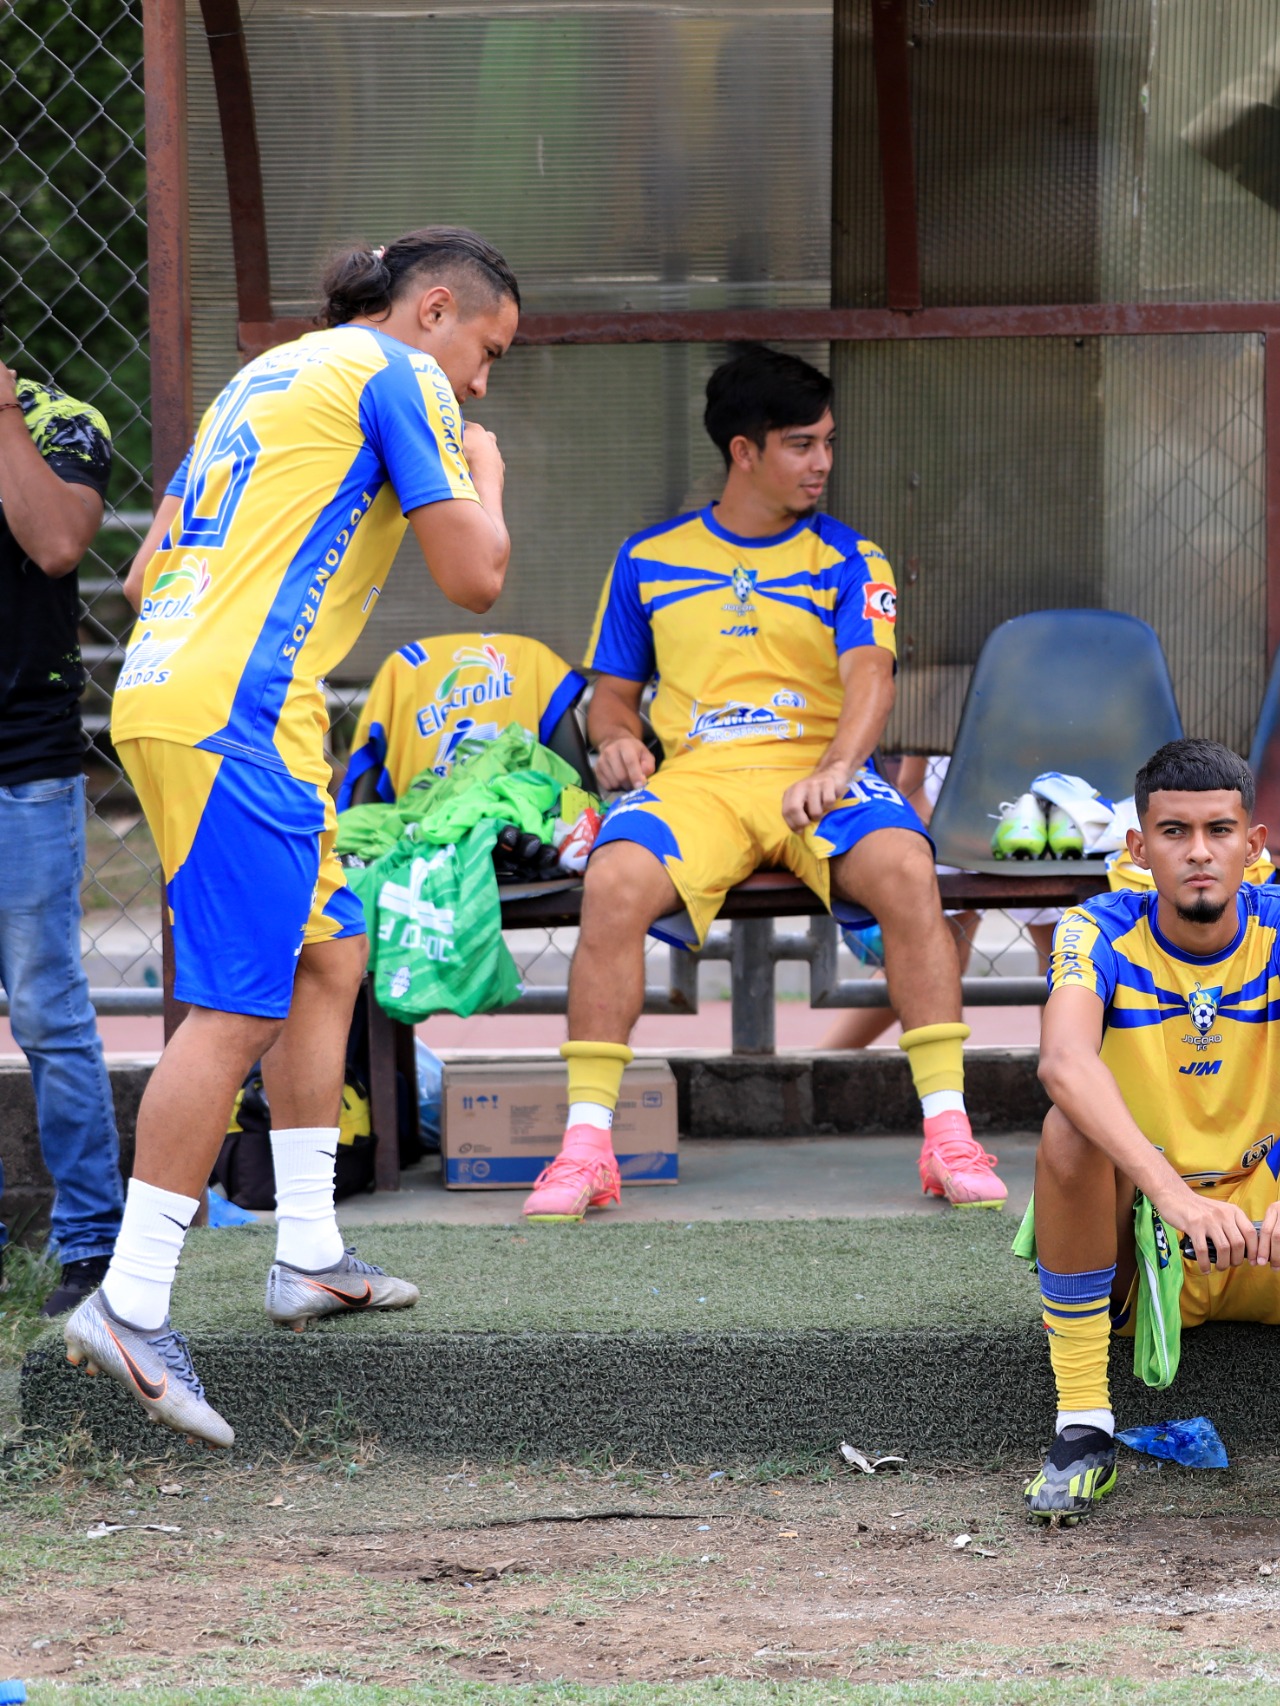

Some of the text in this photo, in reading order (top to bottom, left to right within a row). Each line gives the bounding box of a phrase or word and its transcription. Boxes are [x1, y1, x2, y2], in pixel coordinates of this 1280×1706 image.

[432, 381, 461, 454] JOCORO
[283, 491, 372, 661] FOGONEROS
[1182, 1035, 1222, 1045] JOCORO
